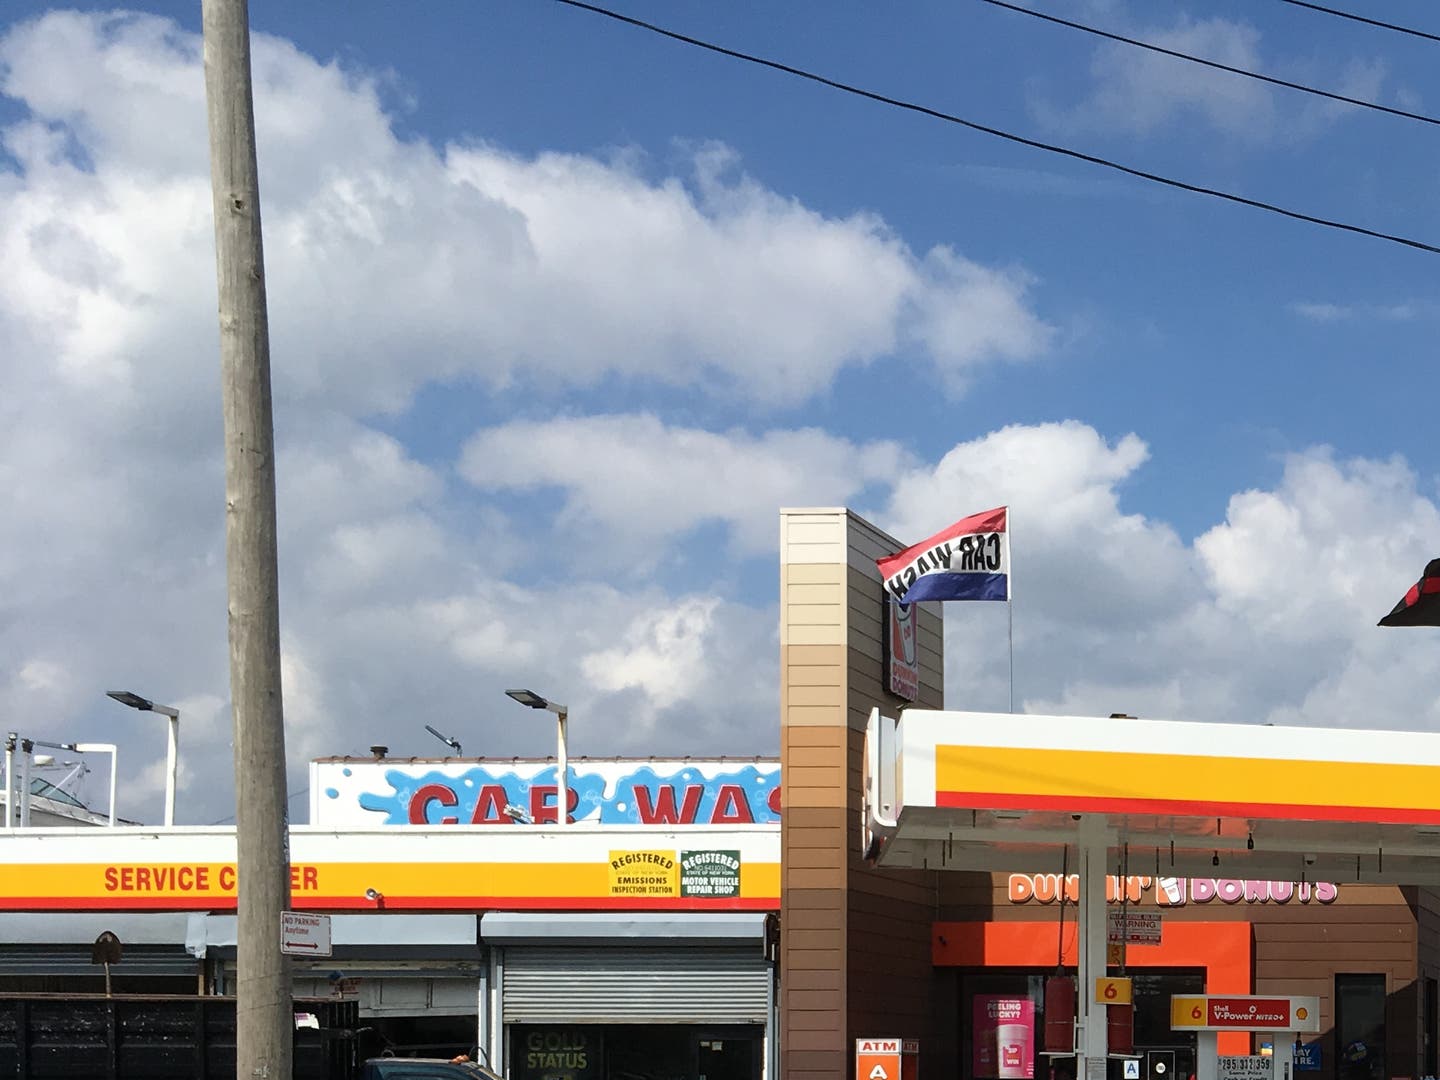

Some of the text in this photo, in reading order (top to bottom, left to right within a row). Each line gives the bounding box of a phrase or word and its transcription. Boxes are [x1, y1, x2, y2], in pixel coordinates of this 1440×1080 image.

[611, 853, 673, 870] REGISTERED
[682, 853, 739, 870] REGISTERED
[104, 866, 319, 891] SERVICE CER
[617, 877, 667, 885] EMISSIONS
[682, 877, 739, 886] MOTOR VEHICLE
[612, 886, 673, 894] INSPECTION STATION
[687, 886, 734, 894] REPAIR SHOP
[1009, 873, 1338, 904] DUNIN' DONUTS
[295, 917, 320, 926] PARKING
[1115, 920, 1156, 928] WARNING
[1104, 983, 1117, 999] 6
[1191, 1006, 1202, 1019] 6
[1214, 1012, 1254, 1020] V-Power
[528, 1031, 587, 1050] GOLD
[862, 1042, 897, 1051] ATM
[528, 1053, 587, 1069] STATUS
[1126, 1063, 1136, 1074] A
